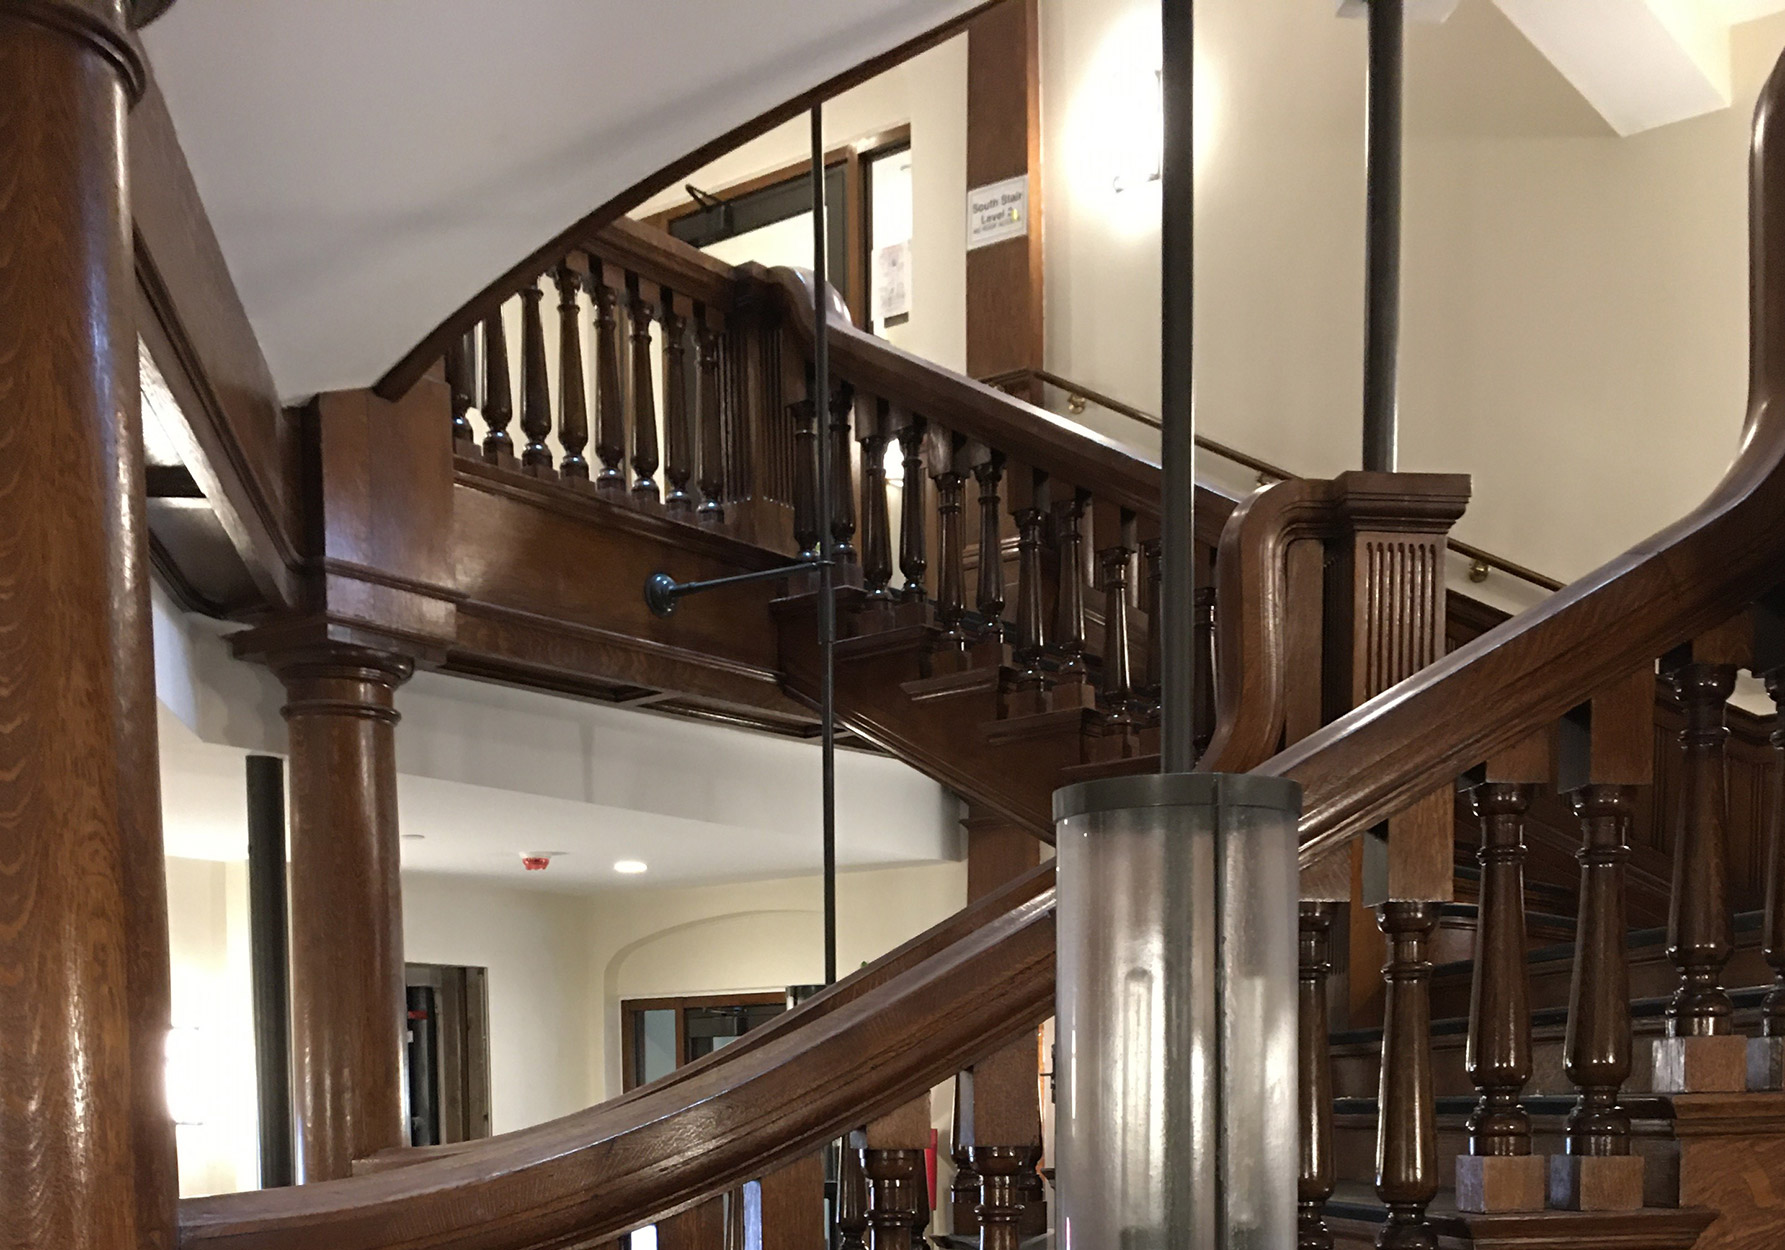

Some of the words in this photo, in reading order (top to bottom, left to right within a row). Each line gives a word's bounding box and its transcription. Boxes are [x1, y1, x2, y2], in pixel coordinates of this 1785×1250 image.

[973, 199, 998, 215] South
[1001, 193, 1022, 206] Stair
[981, 209, 1005, 225] Level
